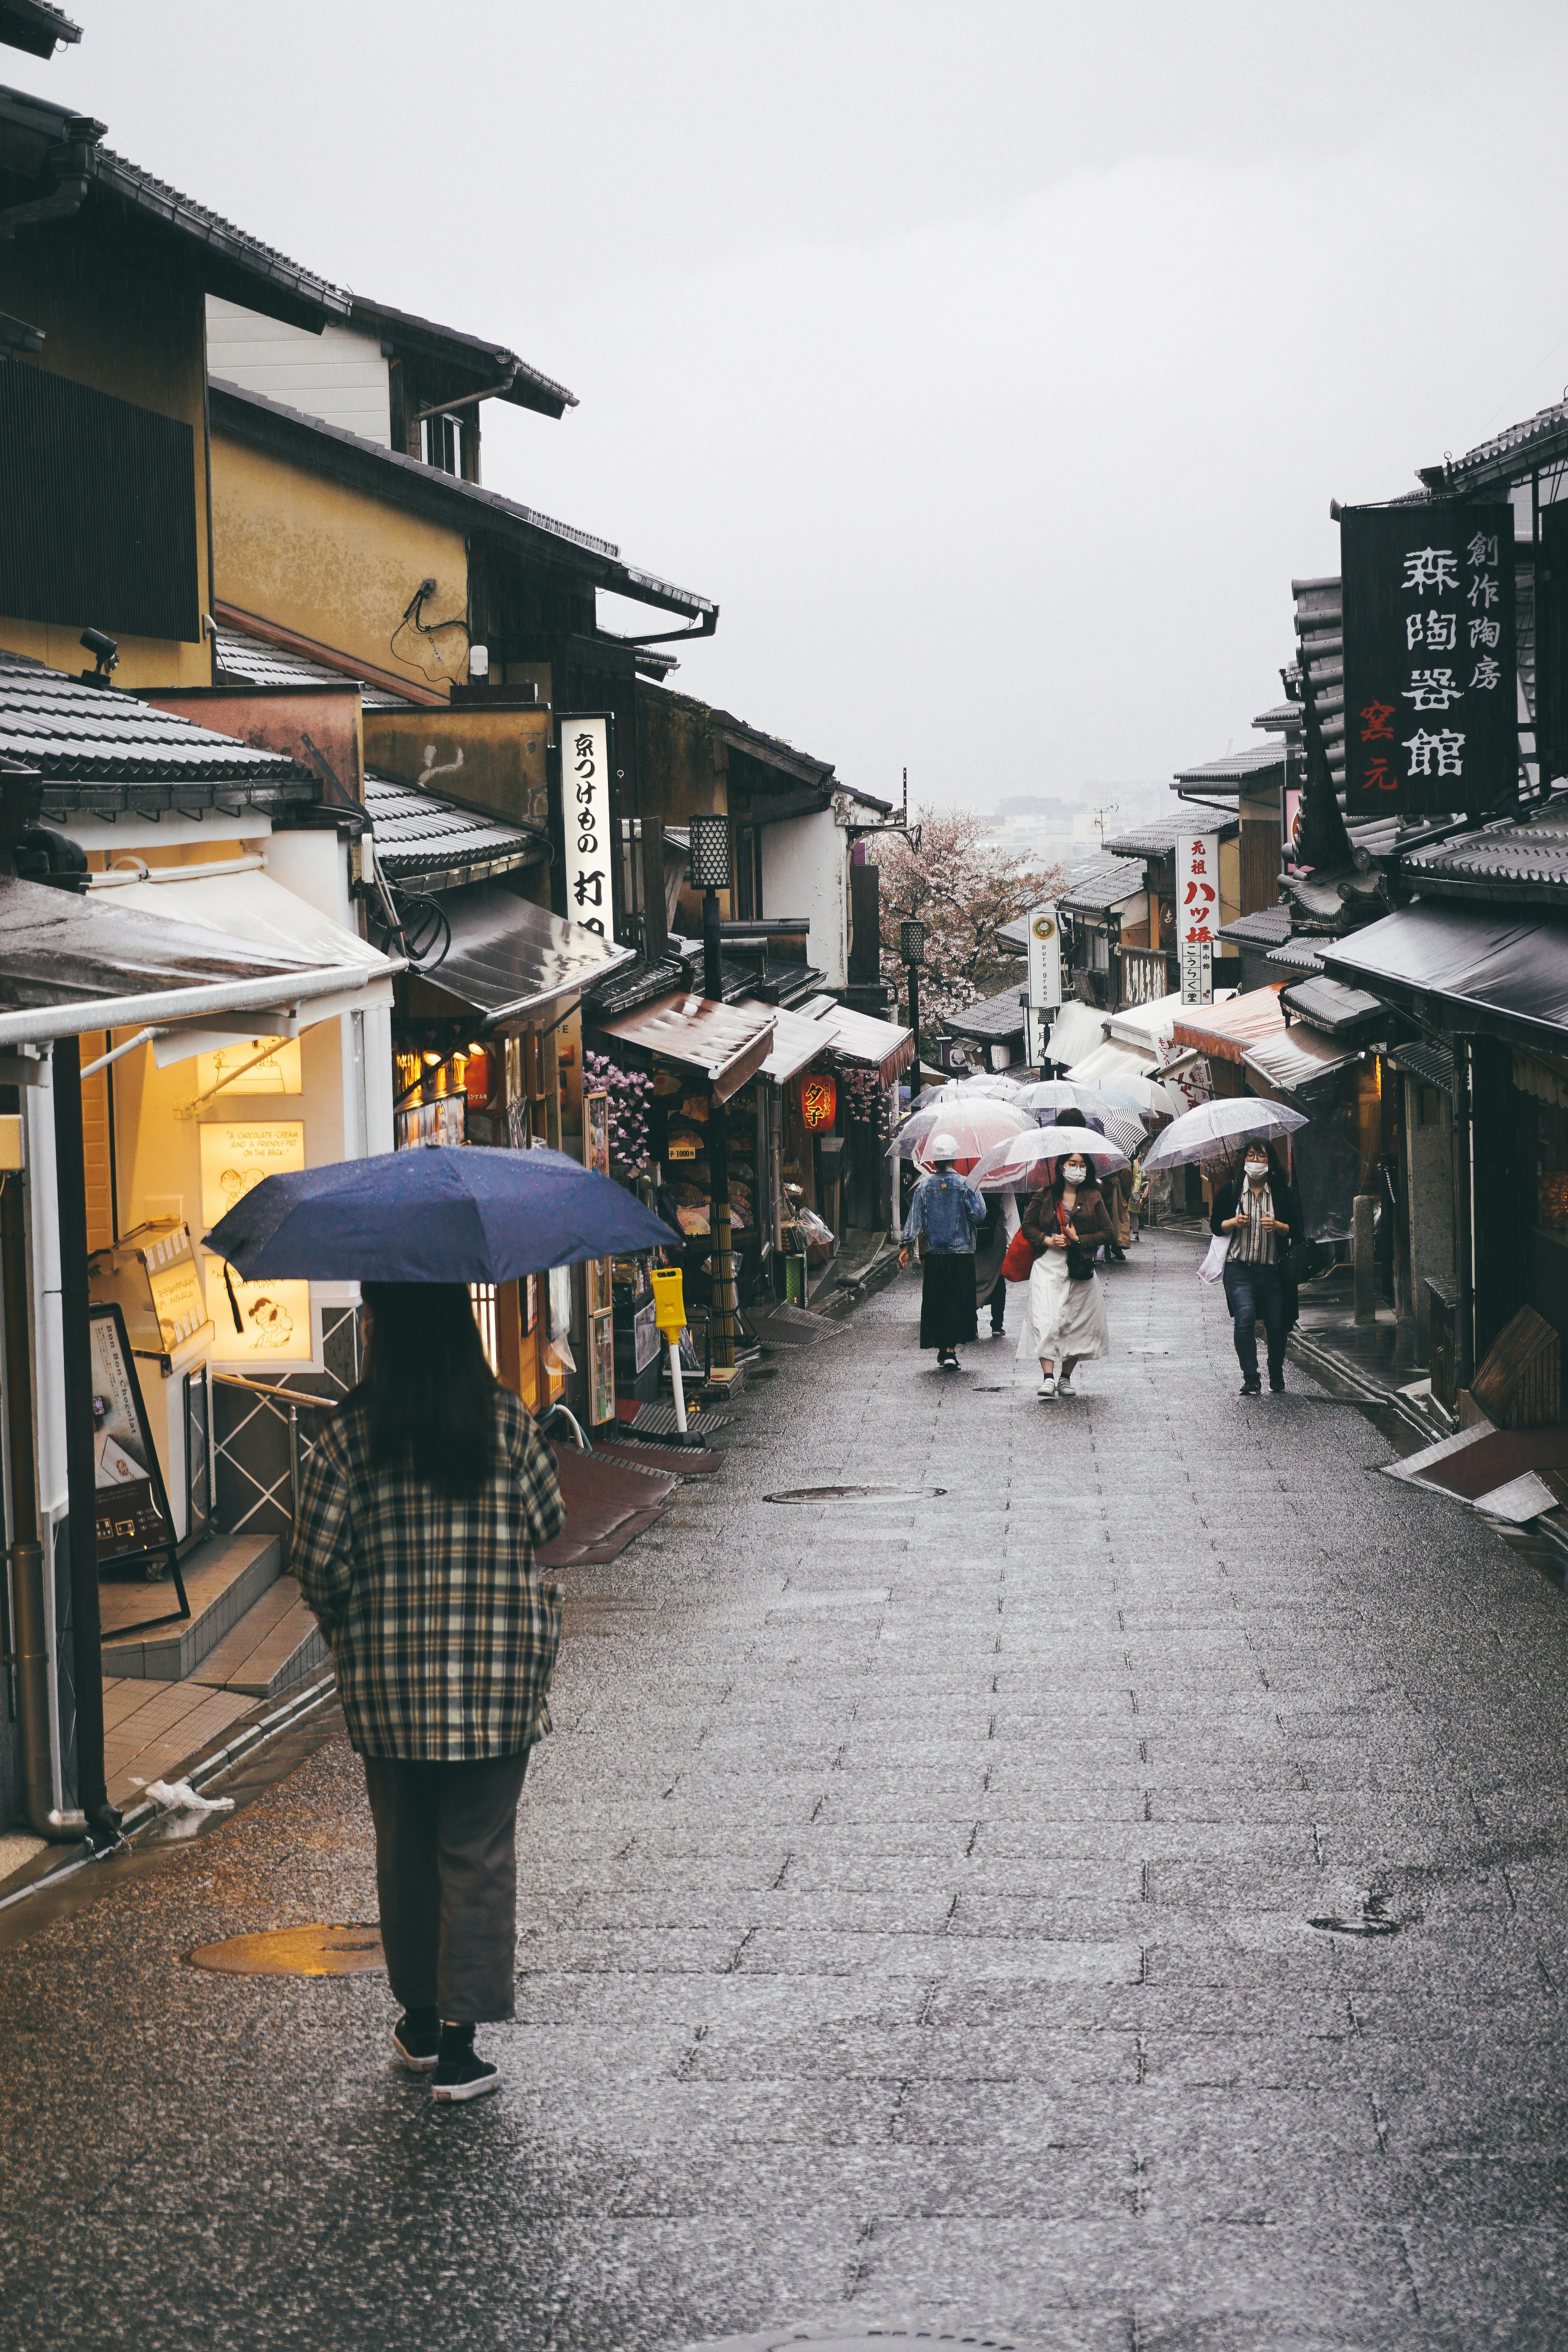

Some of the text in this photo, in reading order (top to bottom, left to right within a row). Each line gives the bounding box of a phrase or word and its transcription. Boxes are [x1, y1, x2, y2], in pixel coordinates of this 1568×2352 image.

[1401, 546, 1465, 777] 森陶器館
[1467, 531, 1501, 690] 創作陶房
[574, 733, 598, 853] 京つけもの
[1361, 700, 1397, 790] 窯元
[1187, 946, 1197, 1002] こうらく堂
[107, 1325, 115, 1348] Bon
[113, 1352, 122, 1376] Bon
[120, 1379, 136, 1434] Chocolat
